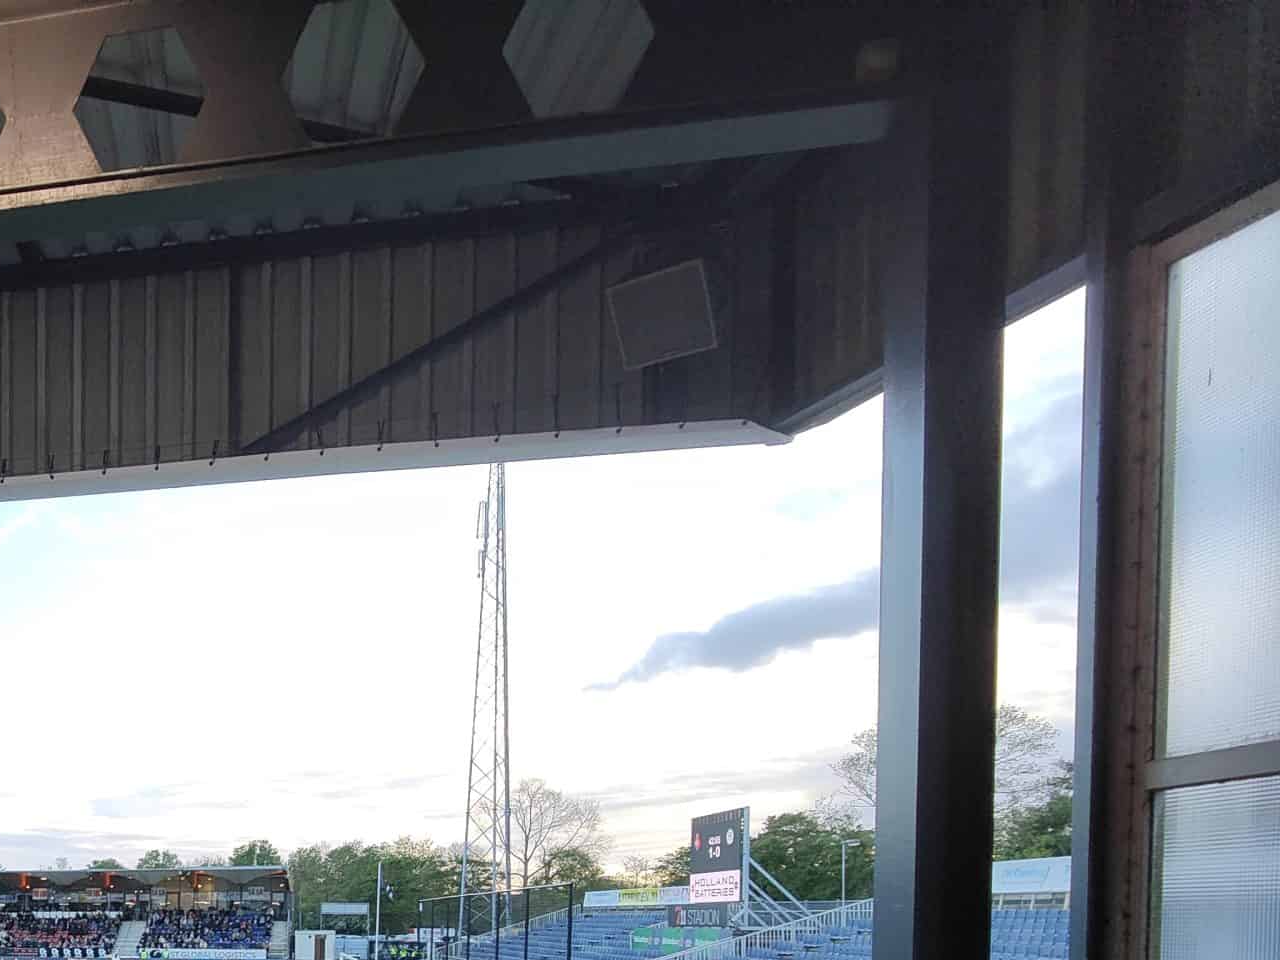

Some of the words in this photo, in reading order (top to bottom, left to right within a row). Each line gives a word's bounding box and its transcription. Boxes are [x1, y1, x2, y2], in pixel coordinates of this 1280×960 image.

[708, 846, 720, 859] 1-0
[694, 875, 735, 888] HOLLAND
[694, 886, 735, 898] BATTERIES
